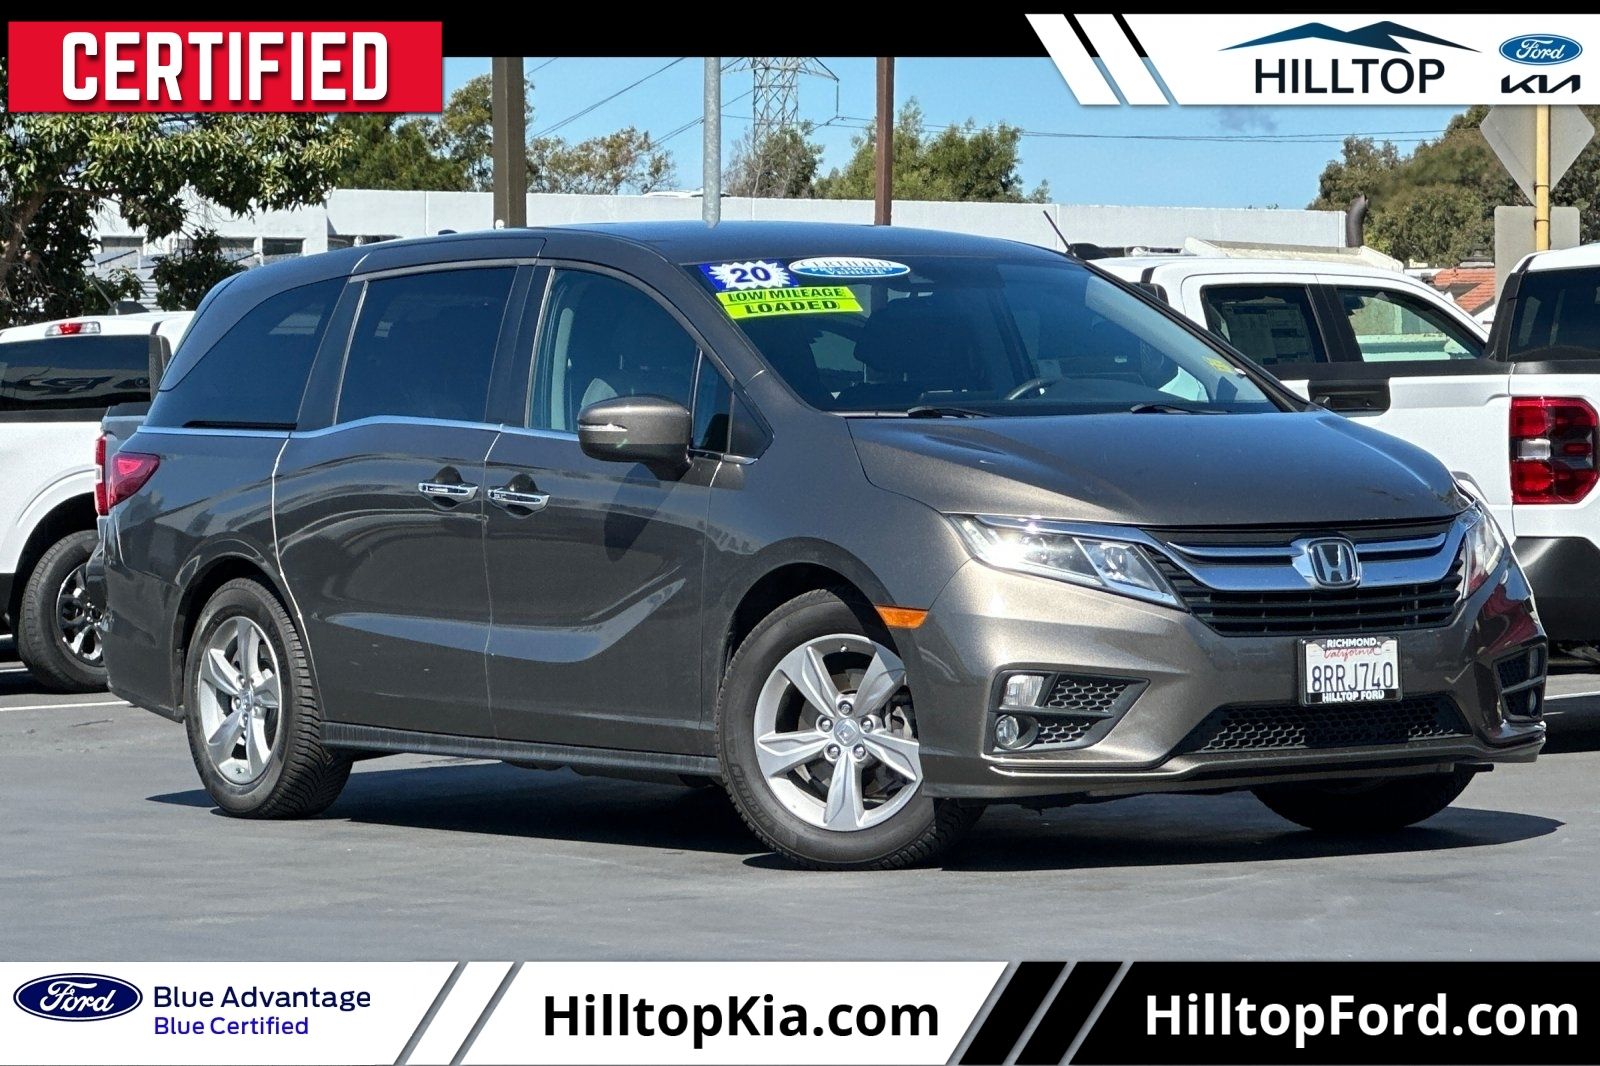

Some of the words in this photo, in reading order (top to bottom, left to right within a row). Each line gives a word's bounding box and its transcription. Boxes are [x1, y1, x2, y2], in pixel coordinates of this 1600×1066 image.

[729, 266, 771, 283] 20
[727, 291, 765, 303] LOW
[768, 287, 844, 300] MILEAGE
[744, 299, 838, 315] LOADED
[1326, 637, 1377, 648] RICHMOND
[1311, 661, 1394, 692] 8RRJ740
[1321, 690, 1359, 704] HILLTOP
[1360, 689, 1385, 700] FORD
